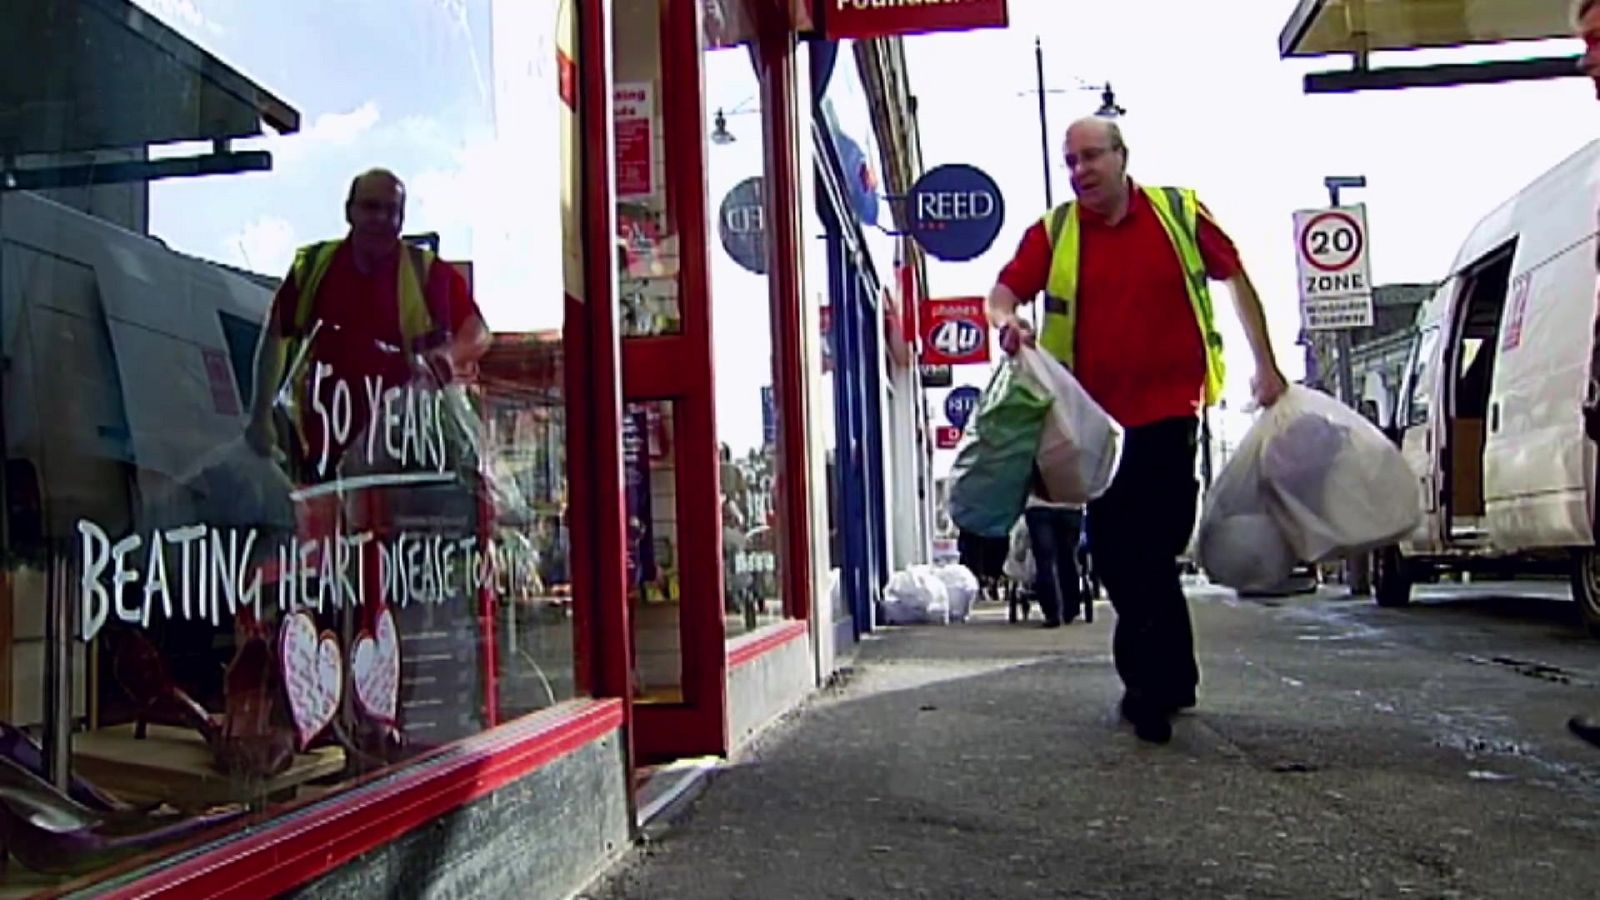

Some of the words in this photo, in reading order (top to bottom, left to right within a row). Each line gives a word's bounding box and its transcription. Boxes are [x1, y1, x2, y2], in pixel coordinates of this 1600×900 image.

[918, 191, 994, 220] REED
[1311, 228, 1354, 255] 20
[1306, 274, 1363, 293] ZONE
[313, 361, 352, 475] 50
[364, 376, 446, 473] YEARS
[78, 519, 262, 641] BEATING
[278, 530, 373, 613] HEART
[377, 531, 457, 610] DISEASE
